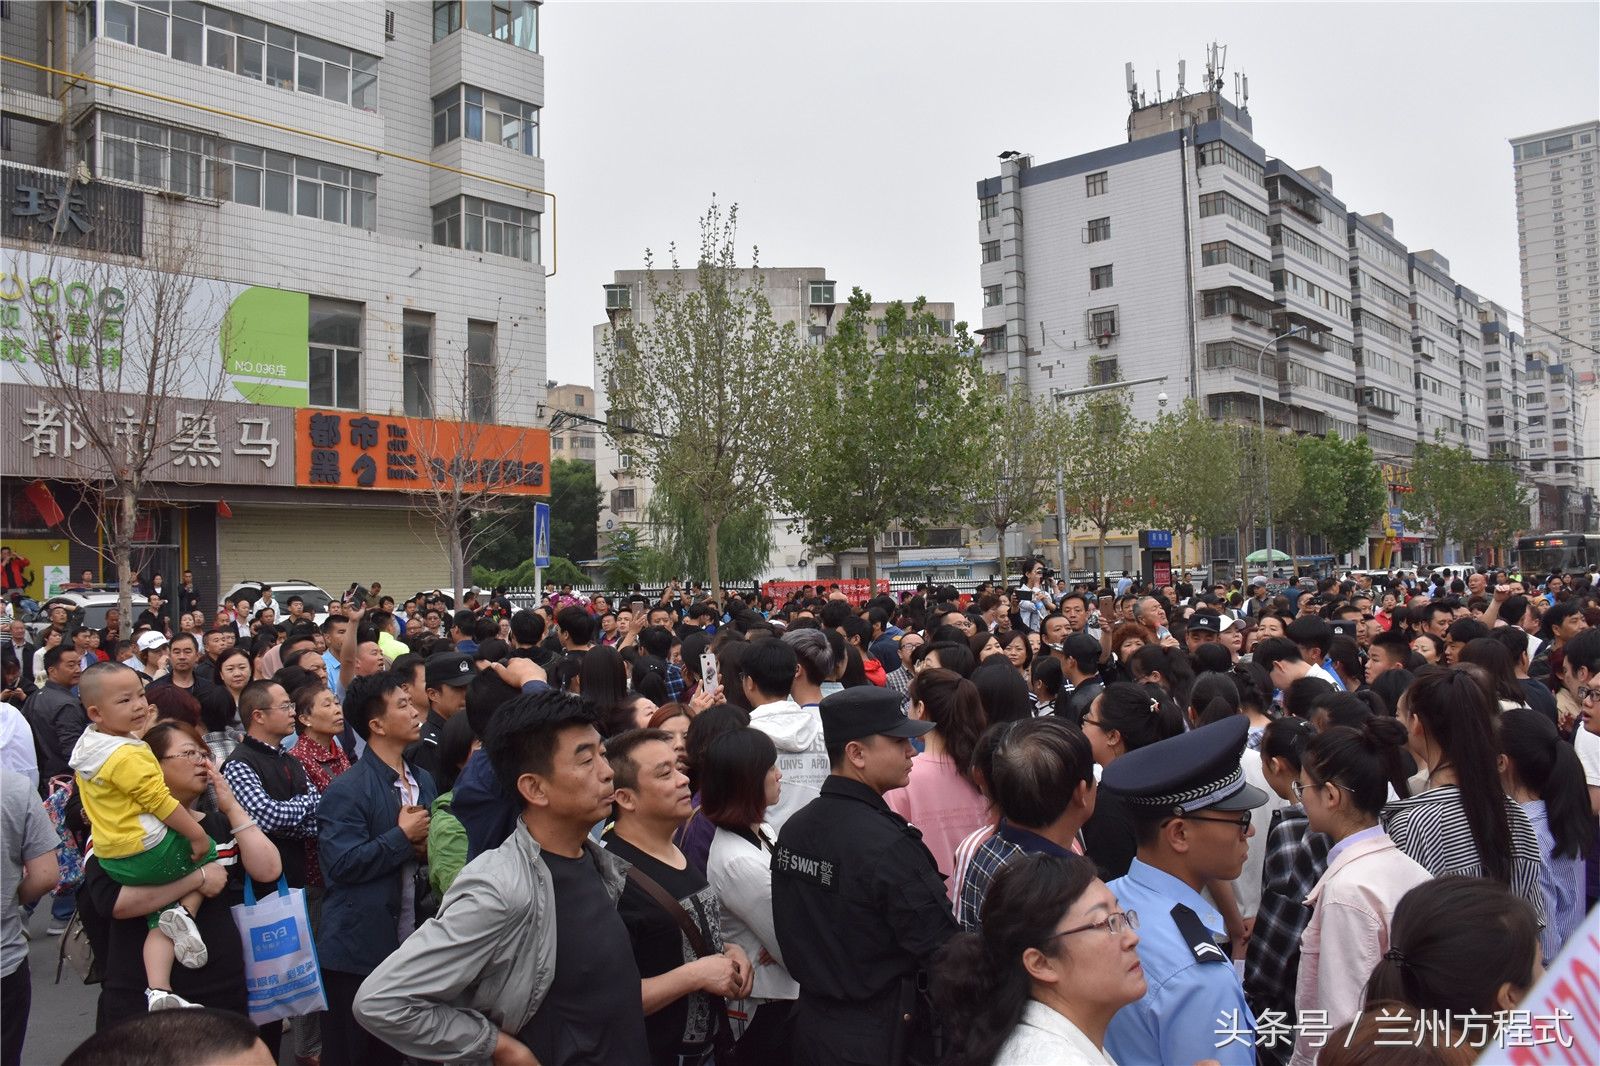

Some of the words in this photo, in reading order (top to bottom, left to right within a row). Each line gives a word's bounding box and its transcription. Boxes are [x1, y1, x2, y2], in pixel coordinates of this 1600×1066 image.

[21, 400, 280, 468] 都市黑马
[309, 412, 379, 450] 都市
[309, 448, 341, 484] 黑
[780, 759, 804, 770] UNVS
